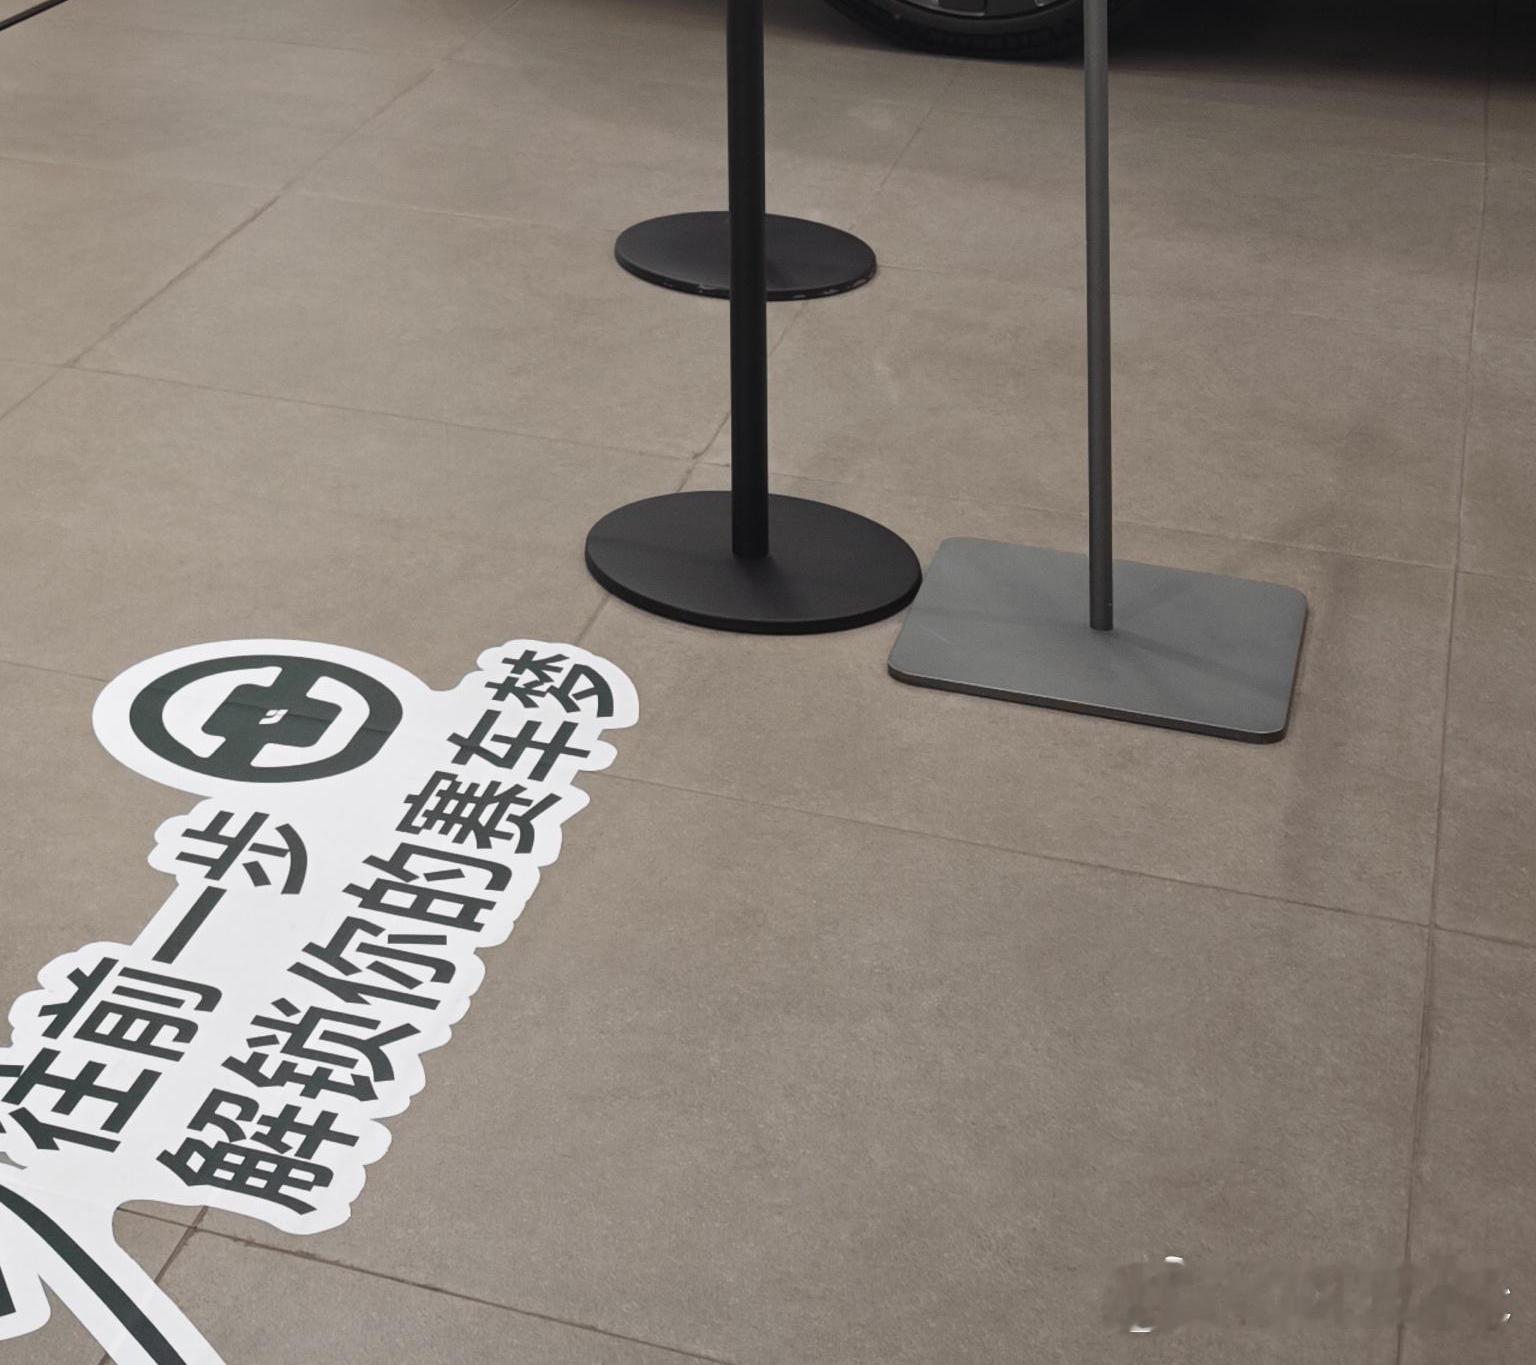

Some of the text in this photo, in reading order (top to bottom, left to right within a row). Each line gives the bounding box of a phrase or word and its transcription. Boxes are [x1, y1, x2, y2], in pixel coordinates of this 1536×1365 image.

[155, 647, 616, 1217] 解锁你的赛车梦
